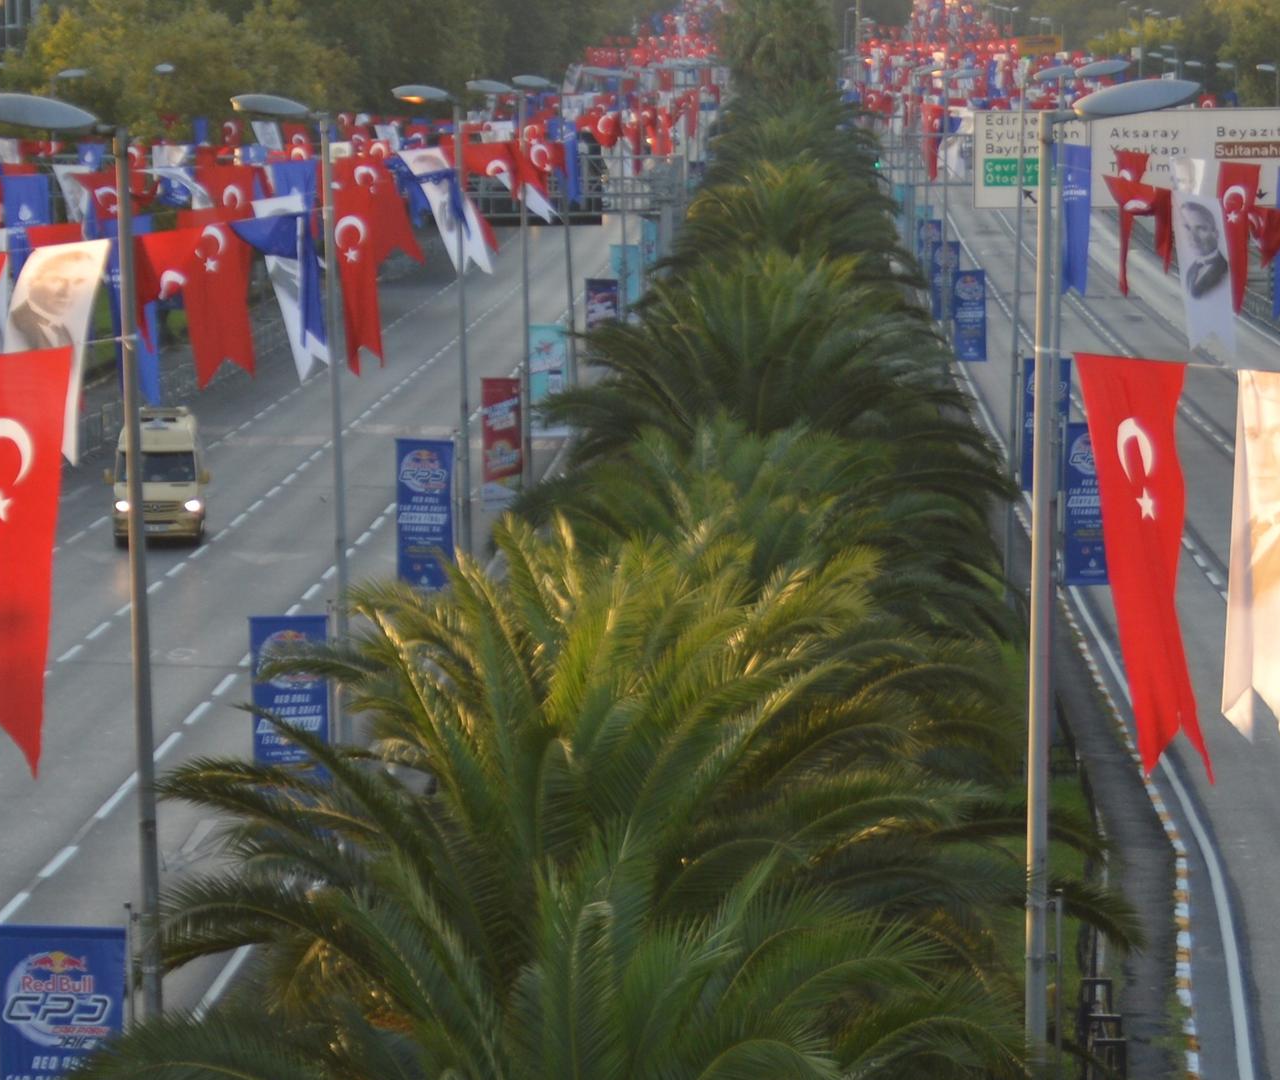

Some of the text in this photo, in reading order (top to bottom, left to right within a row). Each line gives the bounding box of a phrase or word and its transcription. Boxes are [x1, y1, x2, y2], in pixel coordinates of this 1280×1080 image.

[1109, 127, 1180, 140] Aksaray
[22, 975, 94, 992] Red Bull
[32, 1056, 58, 1070] RED
